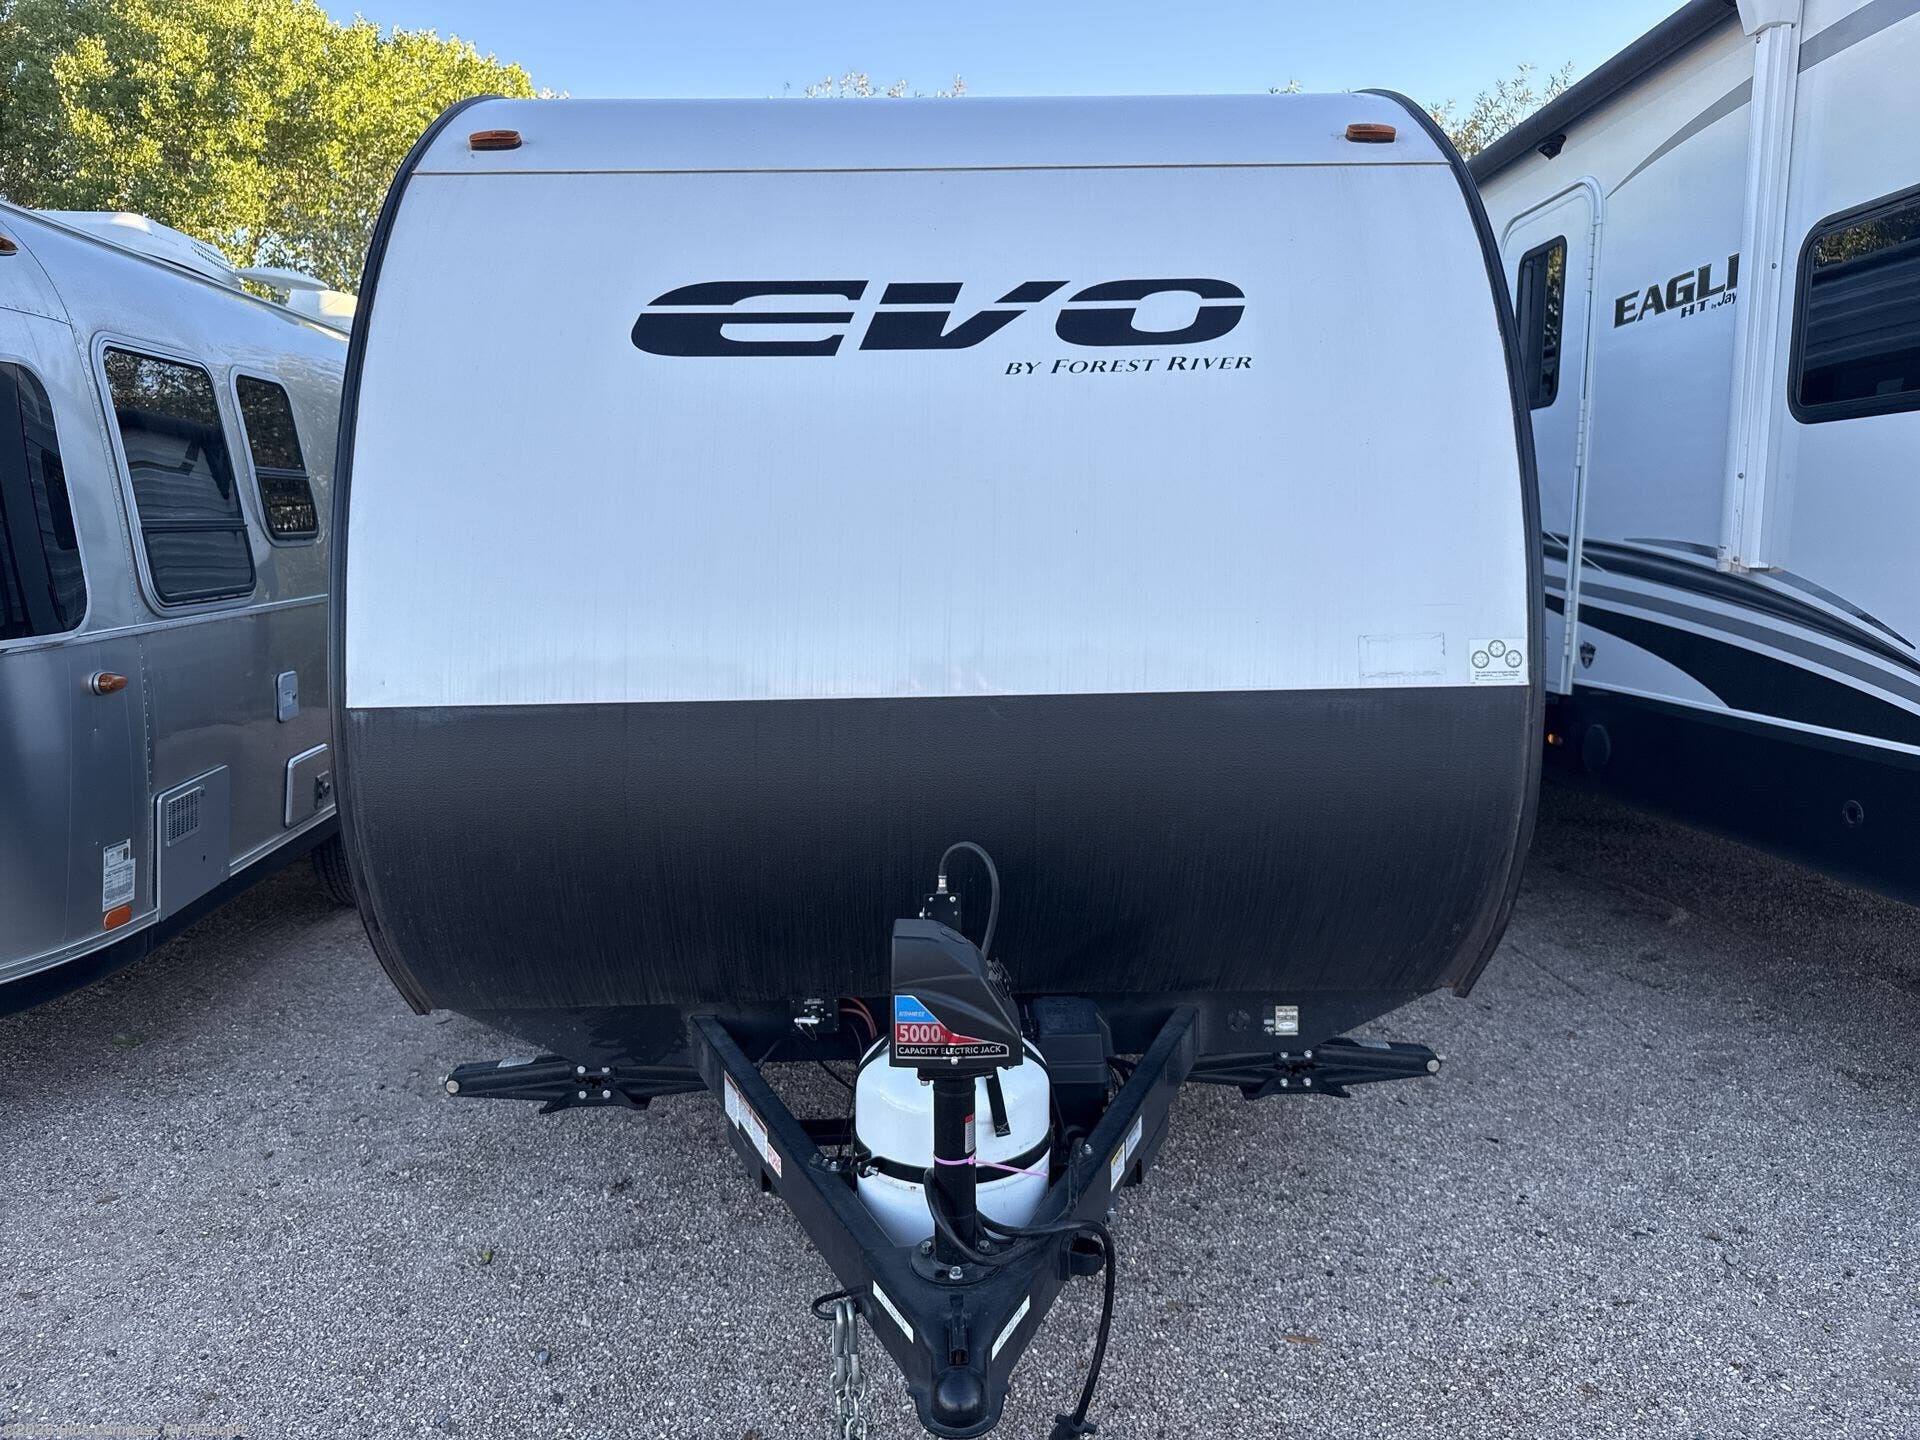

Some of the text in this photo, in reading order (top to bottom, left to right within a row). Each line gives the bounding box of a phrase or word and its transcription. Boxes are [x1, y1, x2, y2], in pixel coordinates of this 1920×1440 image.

[630, 278, 1246, 357] EVO
[1681, 299, 1710, 319] HT
[1005, 356, 1252, 375] BY FOREST RIVER
[899, 1025, 941, 1042] 5000
[898, 1047, 939, 1055] CAPACITY
[940, 1047, 979, 1055] ELECTRIC
